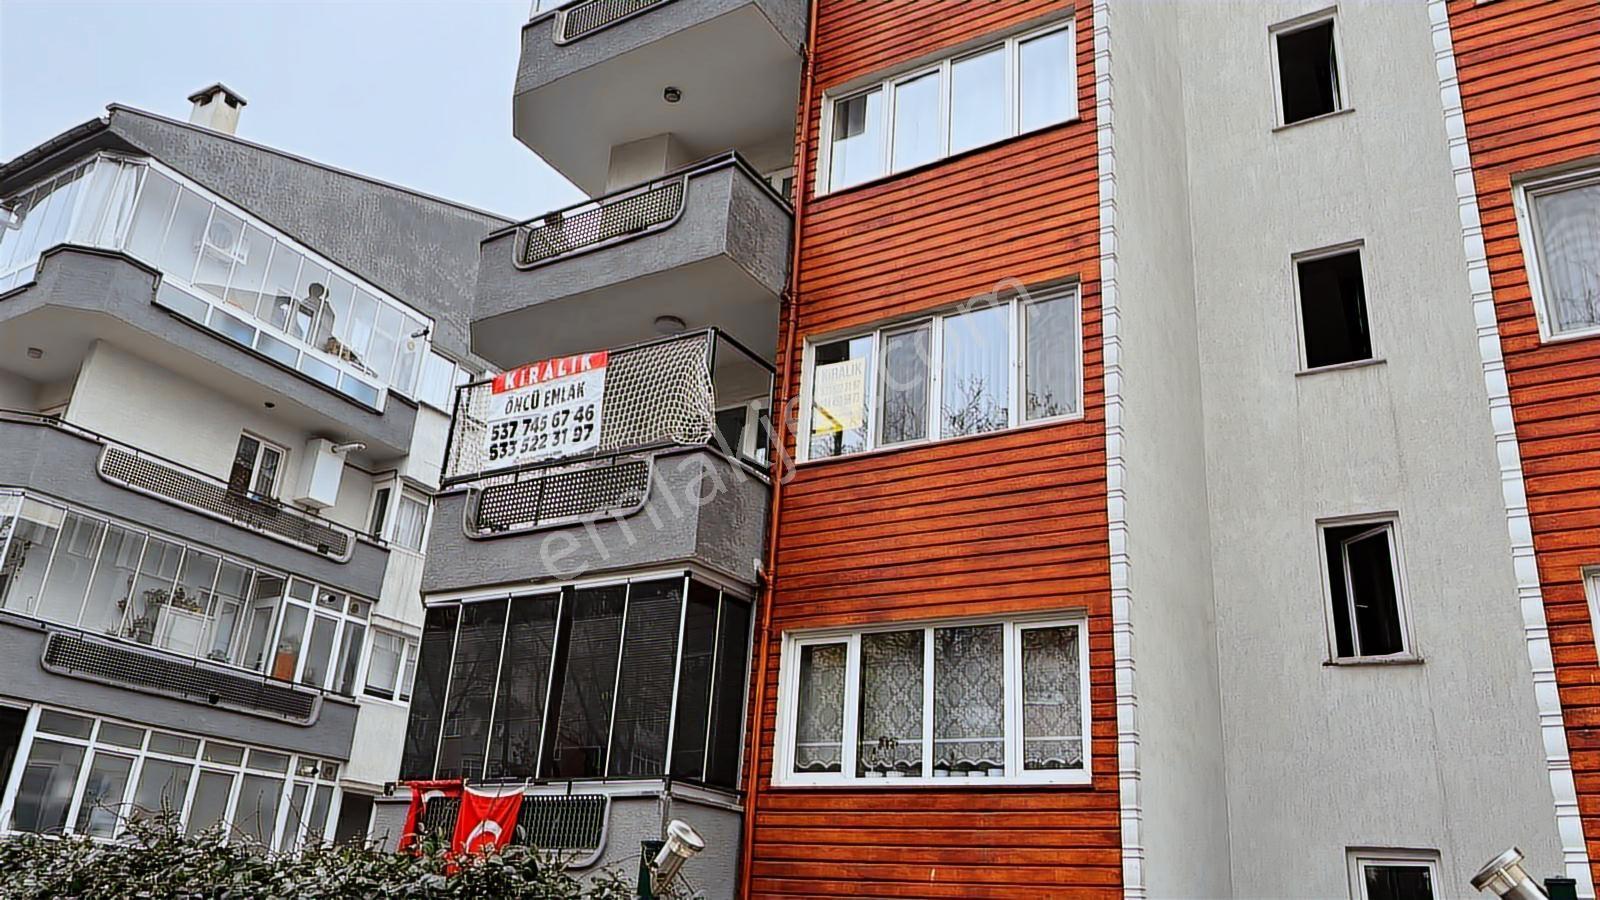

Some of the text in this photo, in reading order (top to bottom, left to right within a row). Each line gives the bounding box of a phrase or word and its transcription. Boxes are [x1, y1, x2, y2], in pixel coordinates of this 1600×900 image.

[505, 381, 585, 415] ÖNCÜ EMLAK
[491, 404, 595, 441] 537 745 67 46
[520, 433, 548, 454] 522
[552, 428, 569, 447] 31
[572, 422, 594, 442] 97
